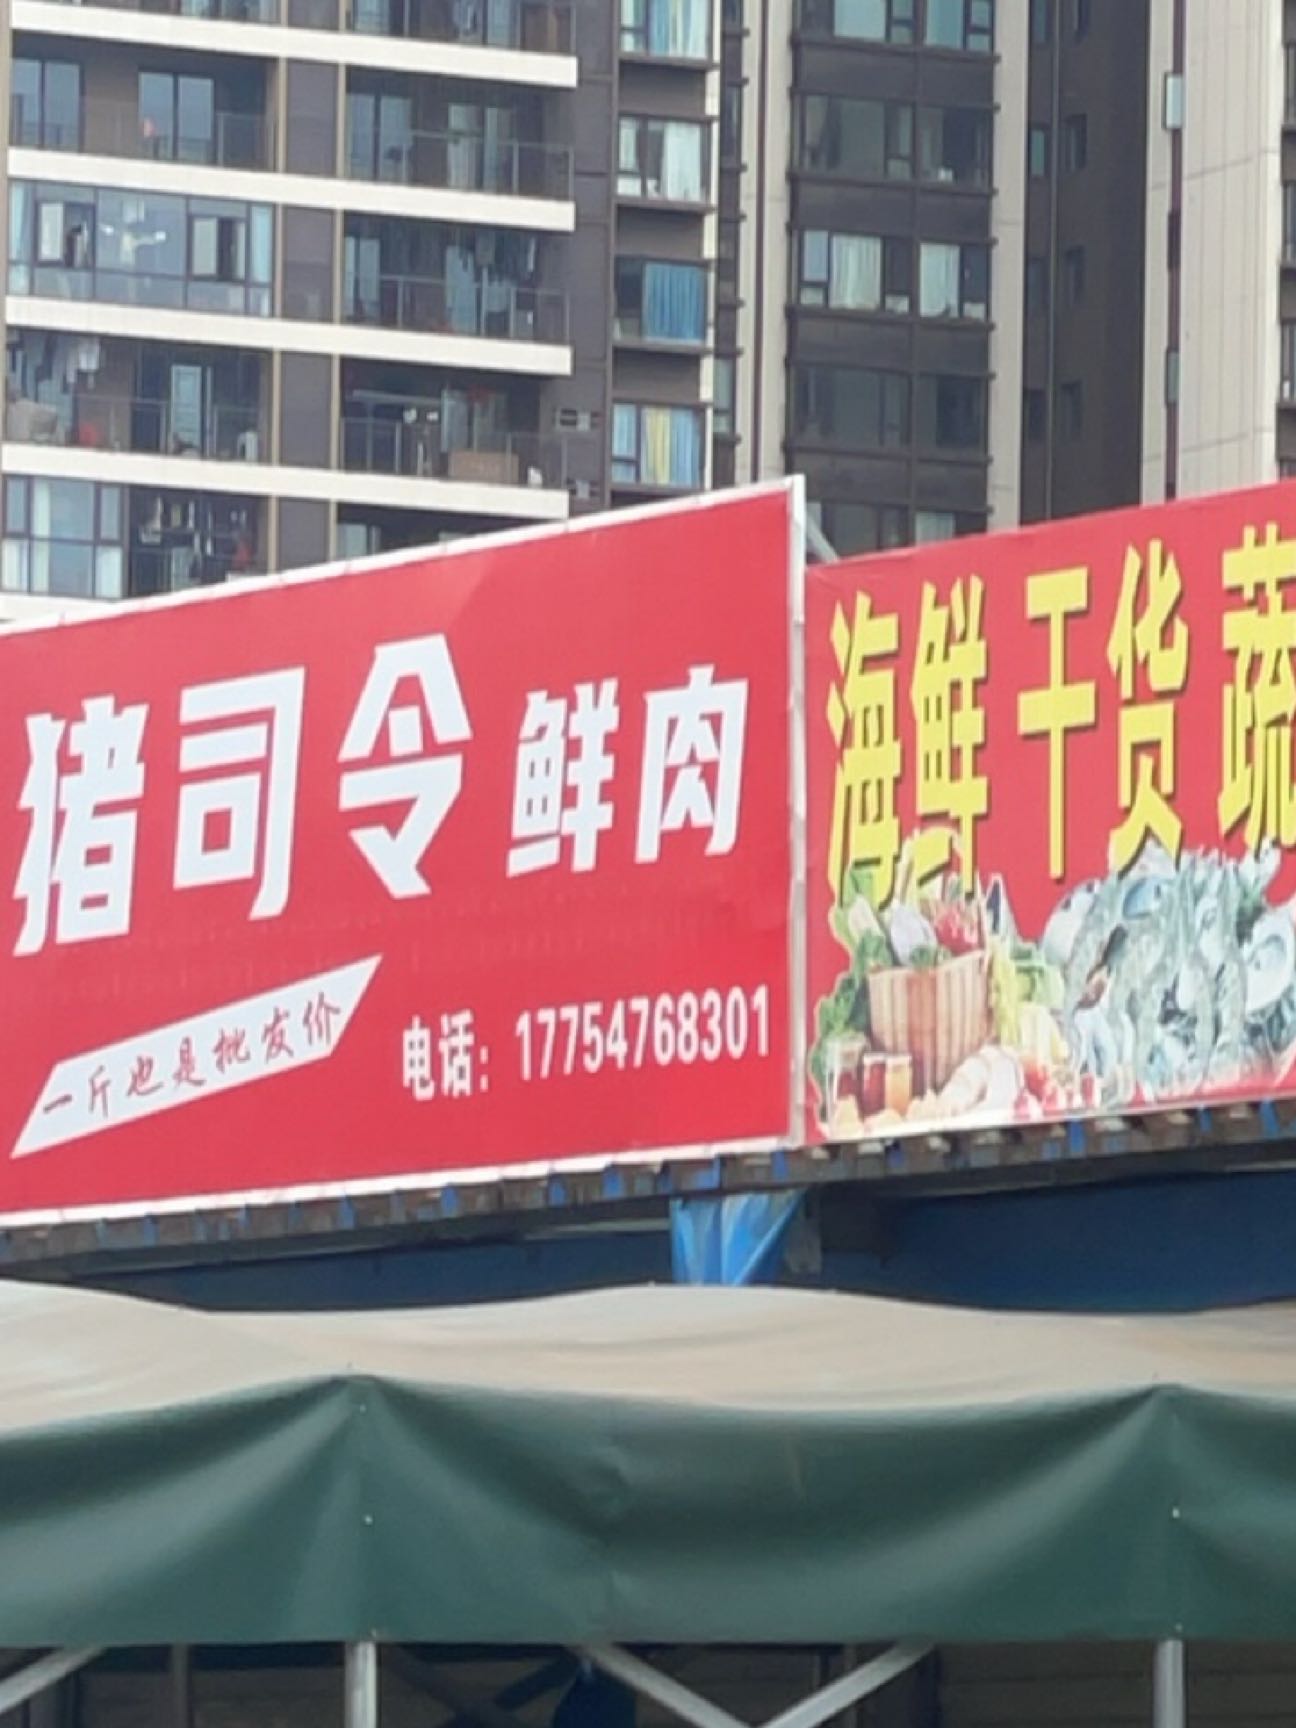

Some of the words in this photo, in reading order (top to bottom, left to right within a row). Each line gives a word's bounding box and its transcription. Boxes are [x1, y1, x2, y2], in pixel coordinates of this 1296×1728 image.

[12, 634, 474, 957] 猪司令
[506, 664, 749, 877] 鲜肉
[826, 573, 990, 911] 海鲜
[1017, 538, 1189, 882] 干货
[42, 991, 341, 1118] 一斤也是批发价
[515, 984, 770, 1082] 17754768301
